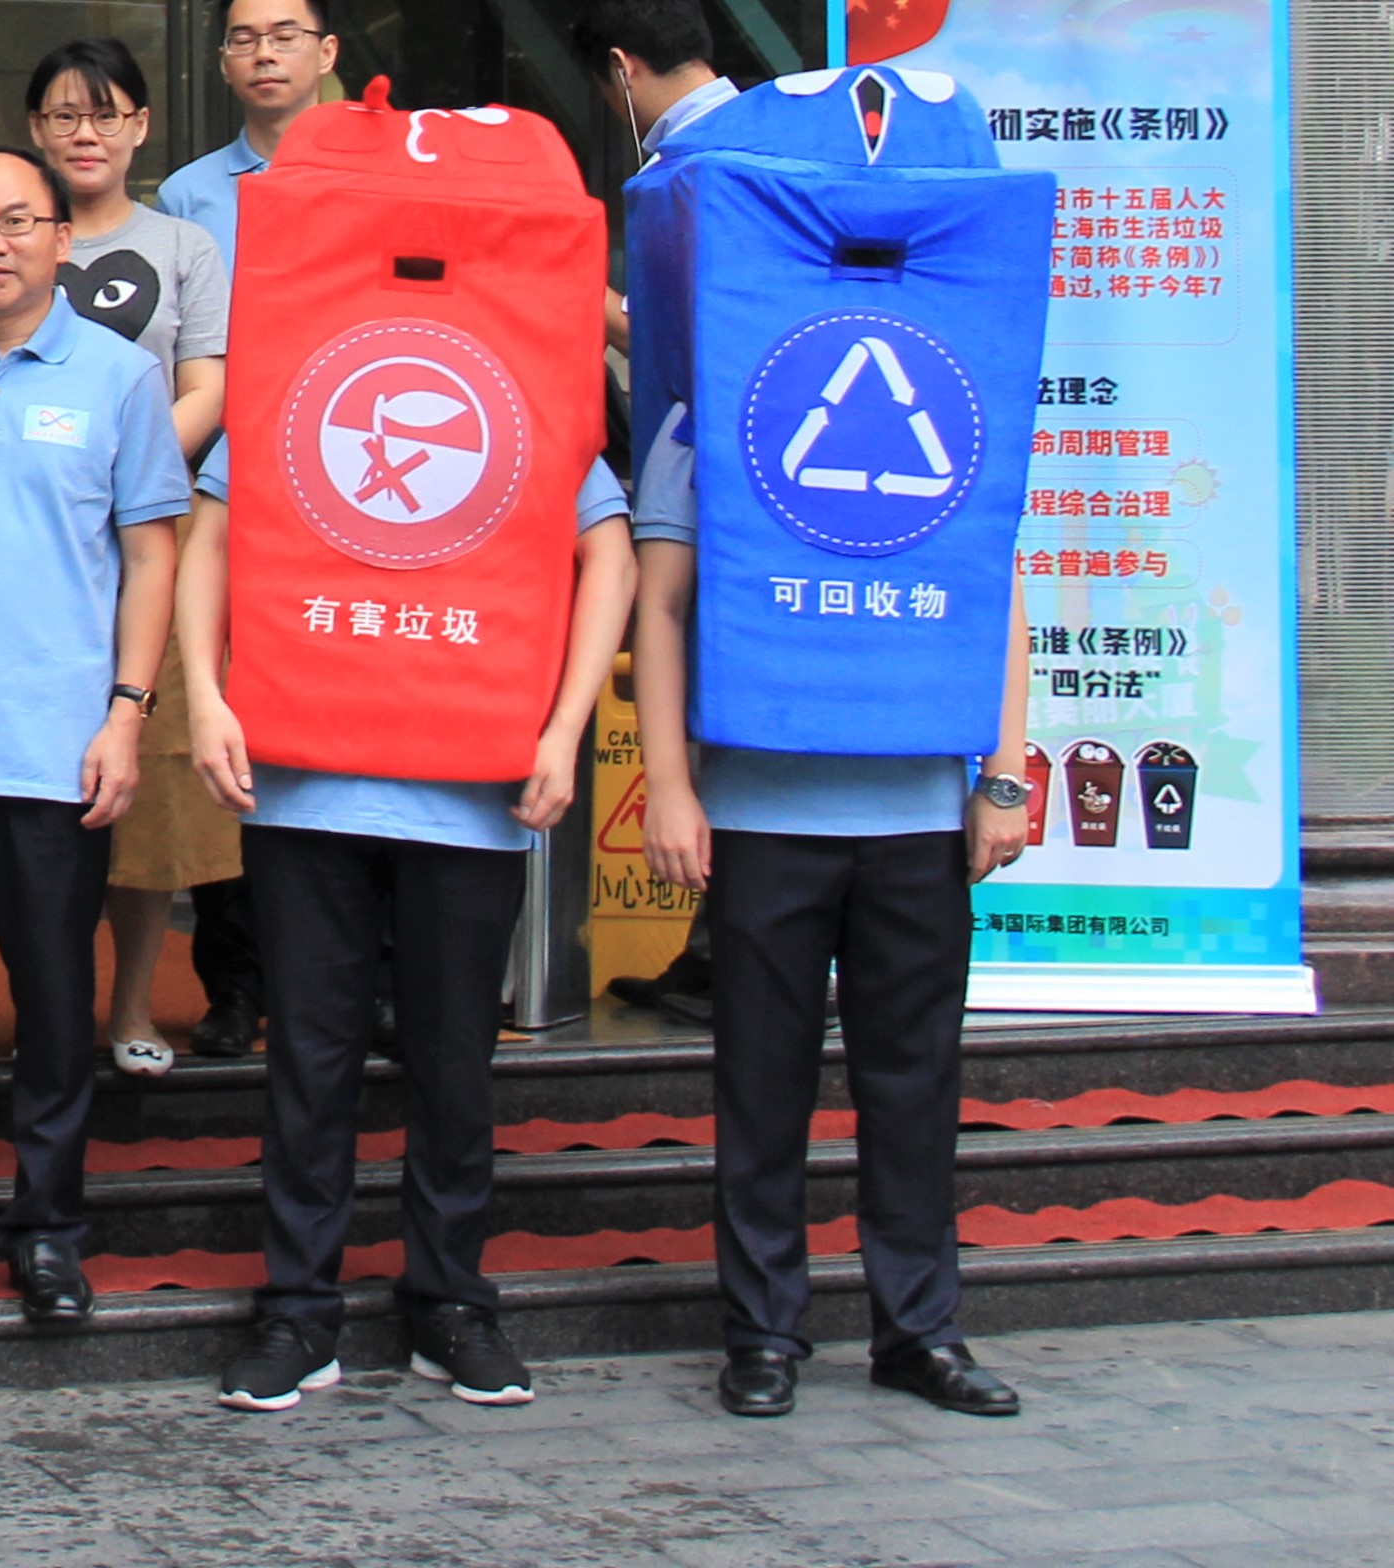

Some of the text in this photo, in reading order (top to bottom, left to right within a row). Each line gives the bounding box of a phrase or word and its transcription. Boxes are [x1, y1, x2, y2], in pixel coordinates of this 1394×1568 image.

[1031, 429, 1171, 457] 命周期管理
[1022, 489, 1172, 518] 程综合治理
[768, 576, 948, 620] 可回收物
[301, 595, 481, 645] 有害垃圾
[597, 749, 635, 764] WET
